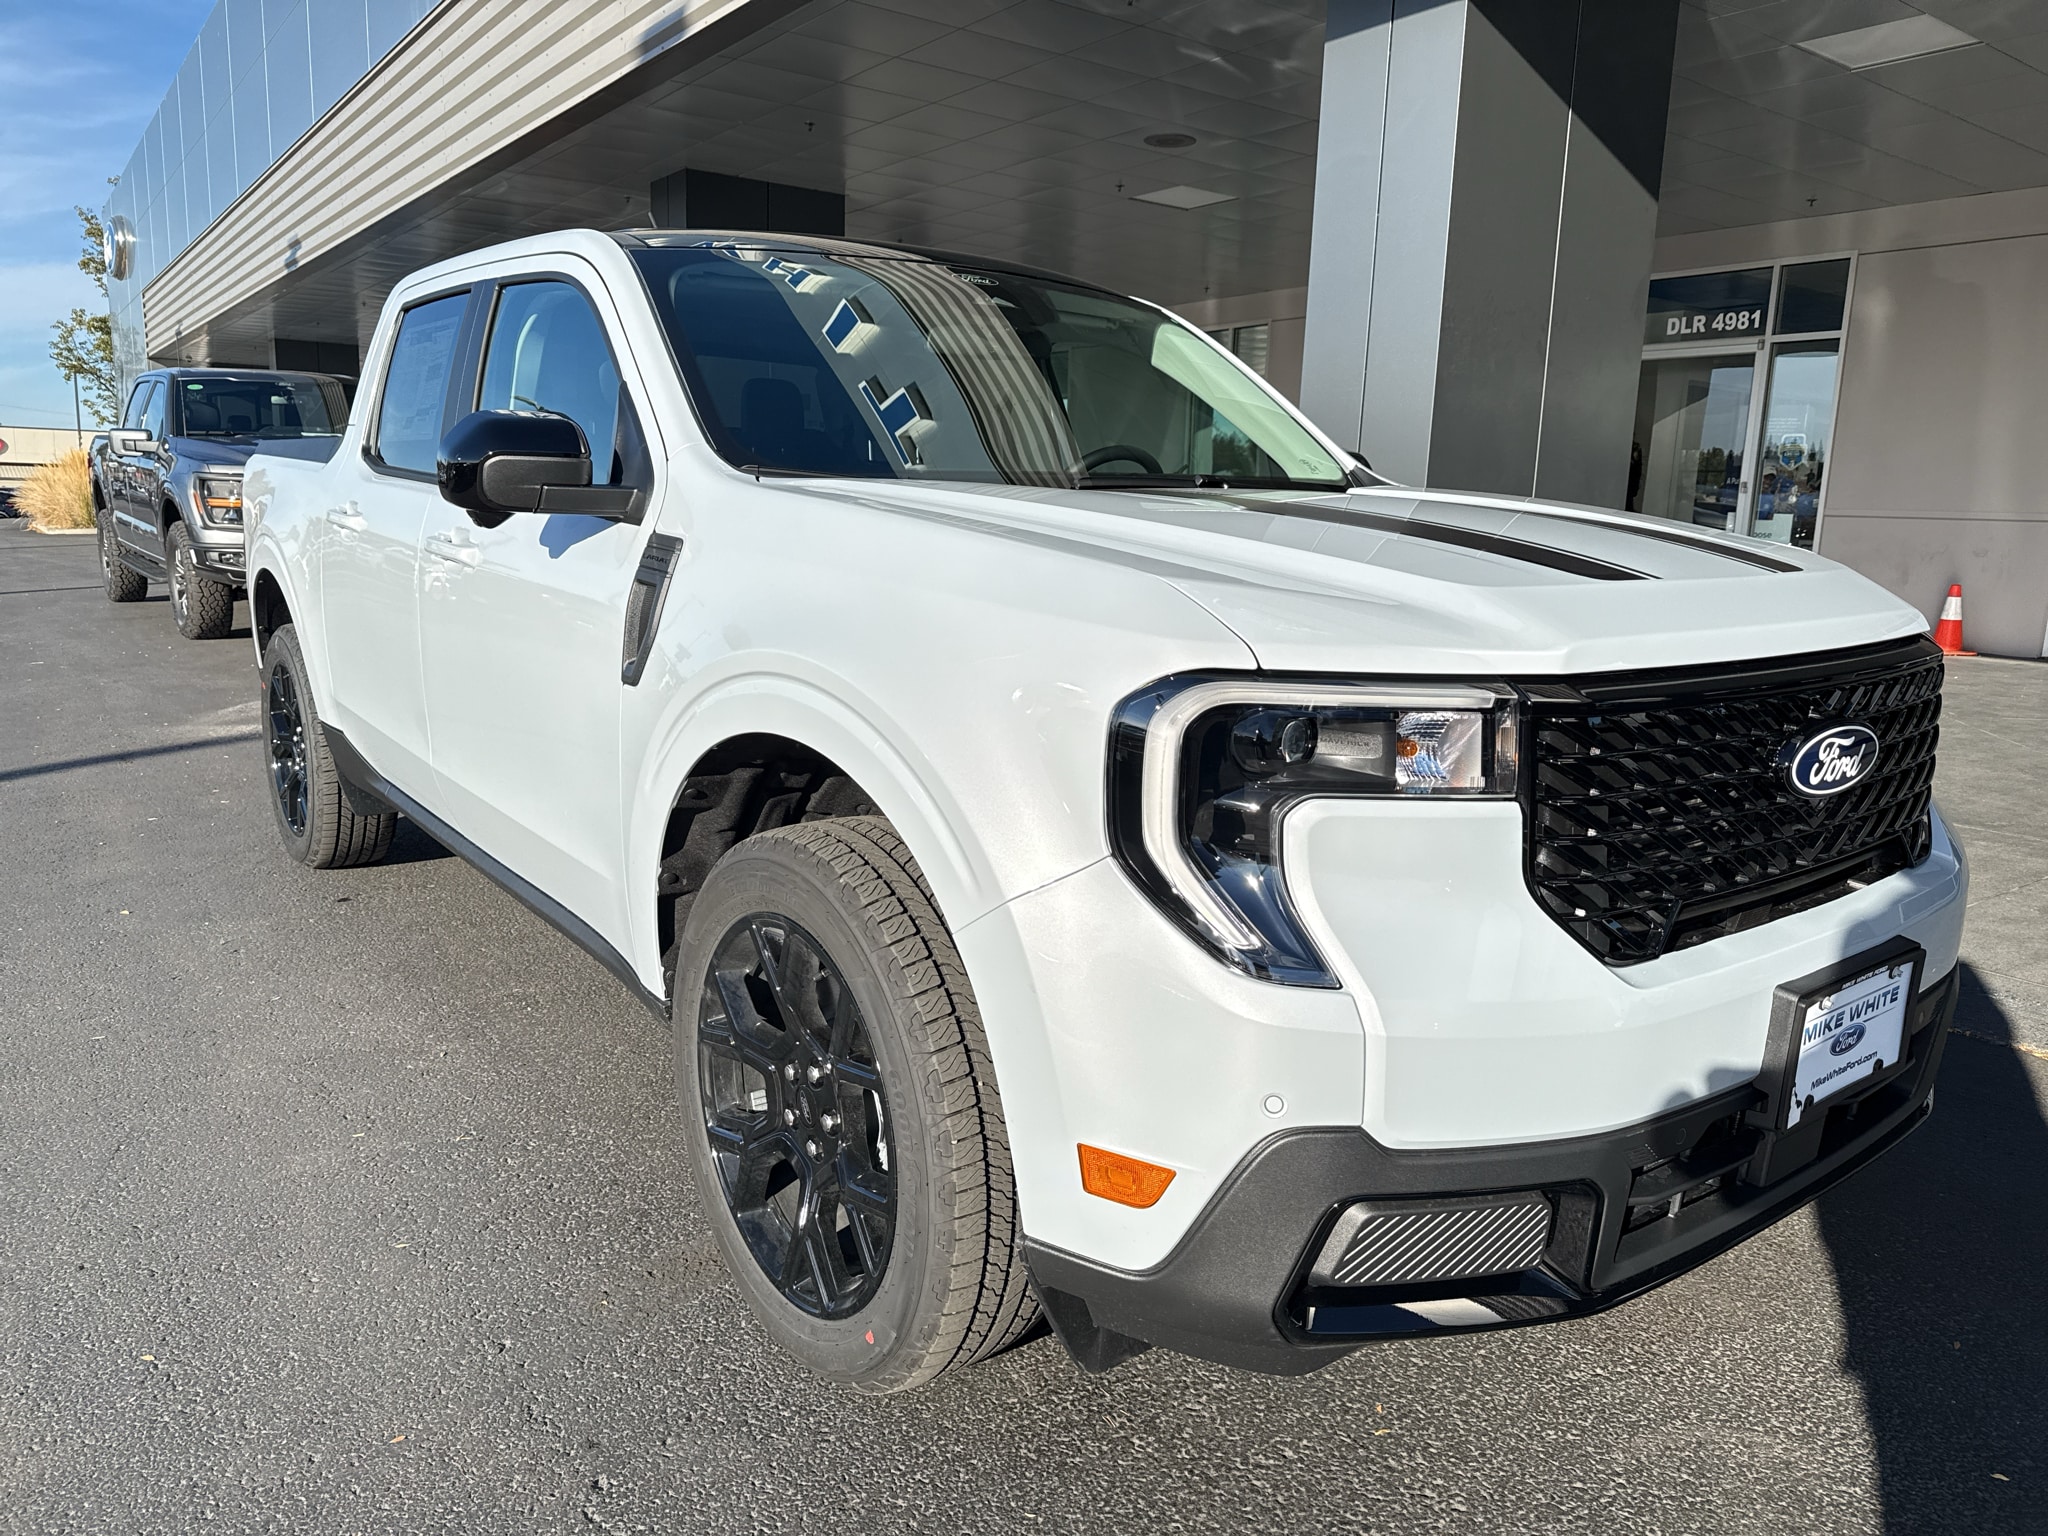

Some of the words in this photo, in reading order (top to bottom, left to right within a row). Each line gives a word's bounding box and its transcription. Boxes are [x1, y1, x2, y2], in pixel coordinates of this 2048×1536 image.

[1666, 315, 1706, 336] DLR
[1711, 309, 1761, 331] 4981
[1809, 736, 1866, 785] Ford
[1803, 1010, 1846, 1046] MIKE
[1850, 985, 1900, 1022] WHITE
[1836, 1027, 1860, 1052] Ford
[1810, 1050, 1878, 1091] MikeWhiteFord.com
